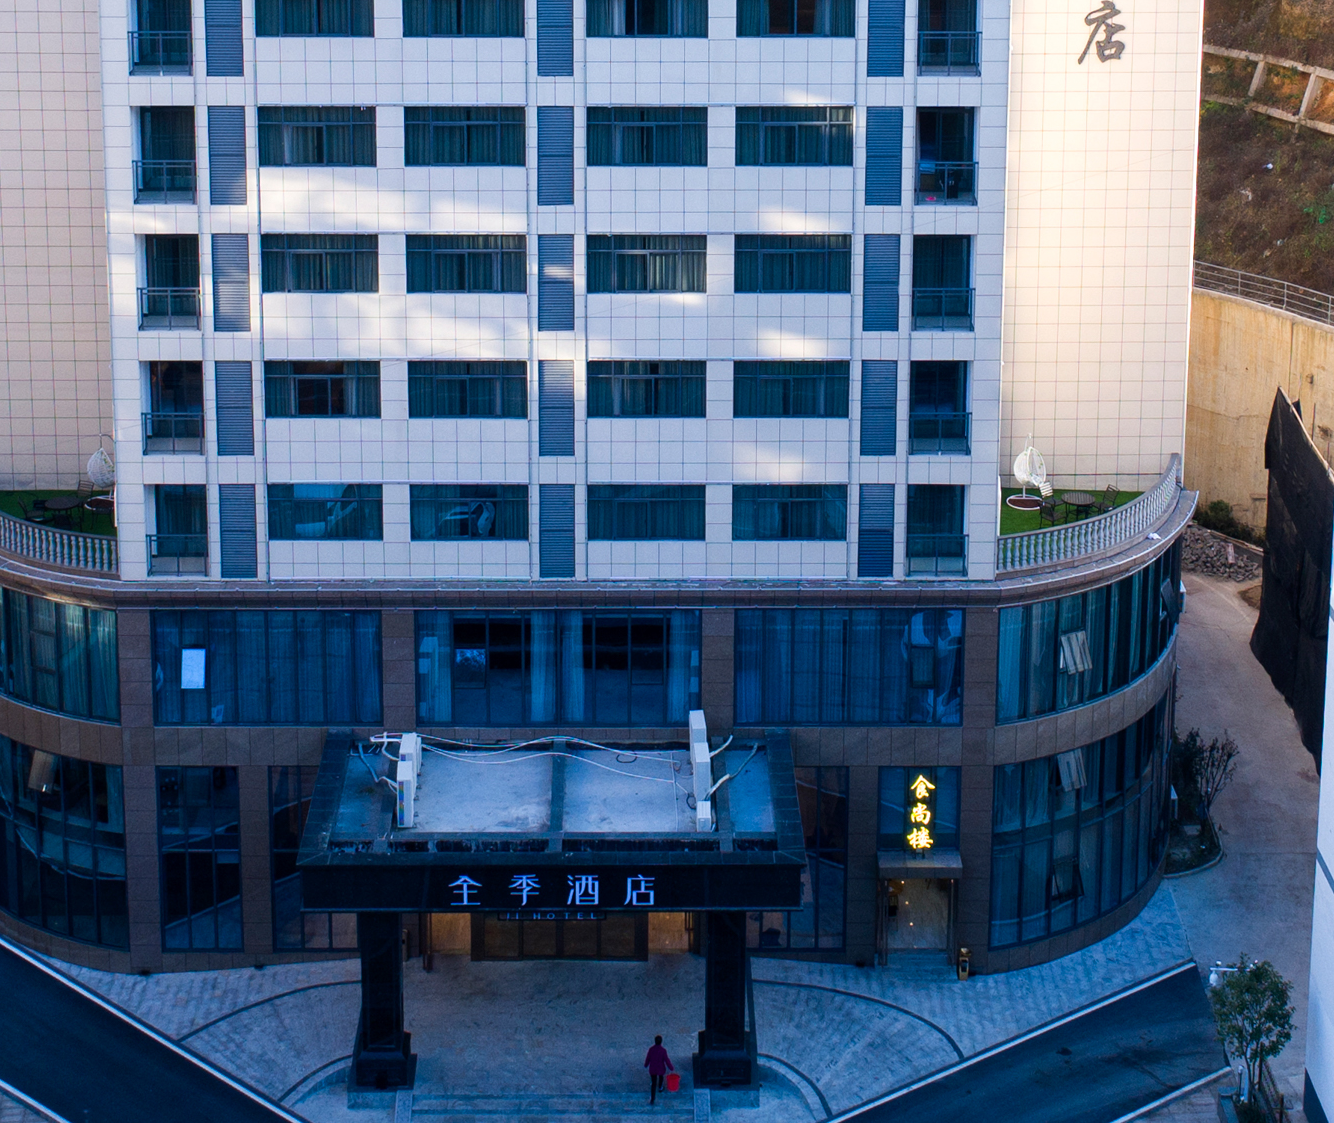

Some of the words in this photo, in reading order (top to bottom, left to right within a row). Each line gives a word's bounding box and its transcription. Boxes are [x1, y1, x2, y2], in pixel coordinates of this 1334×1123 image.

[907, 774, 936, 850] 食尚楼
[448, 874, 656, 906] 全季酒店
[532, 912, 598, 920] HOTEL
